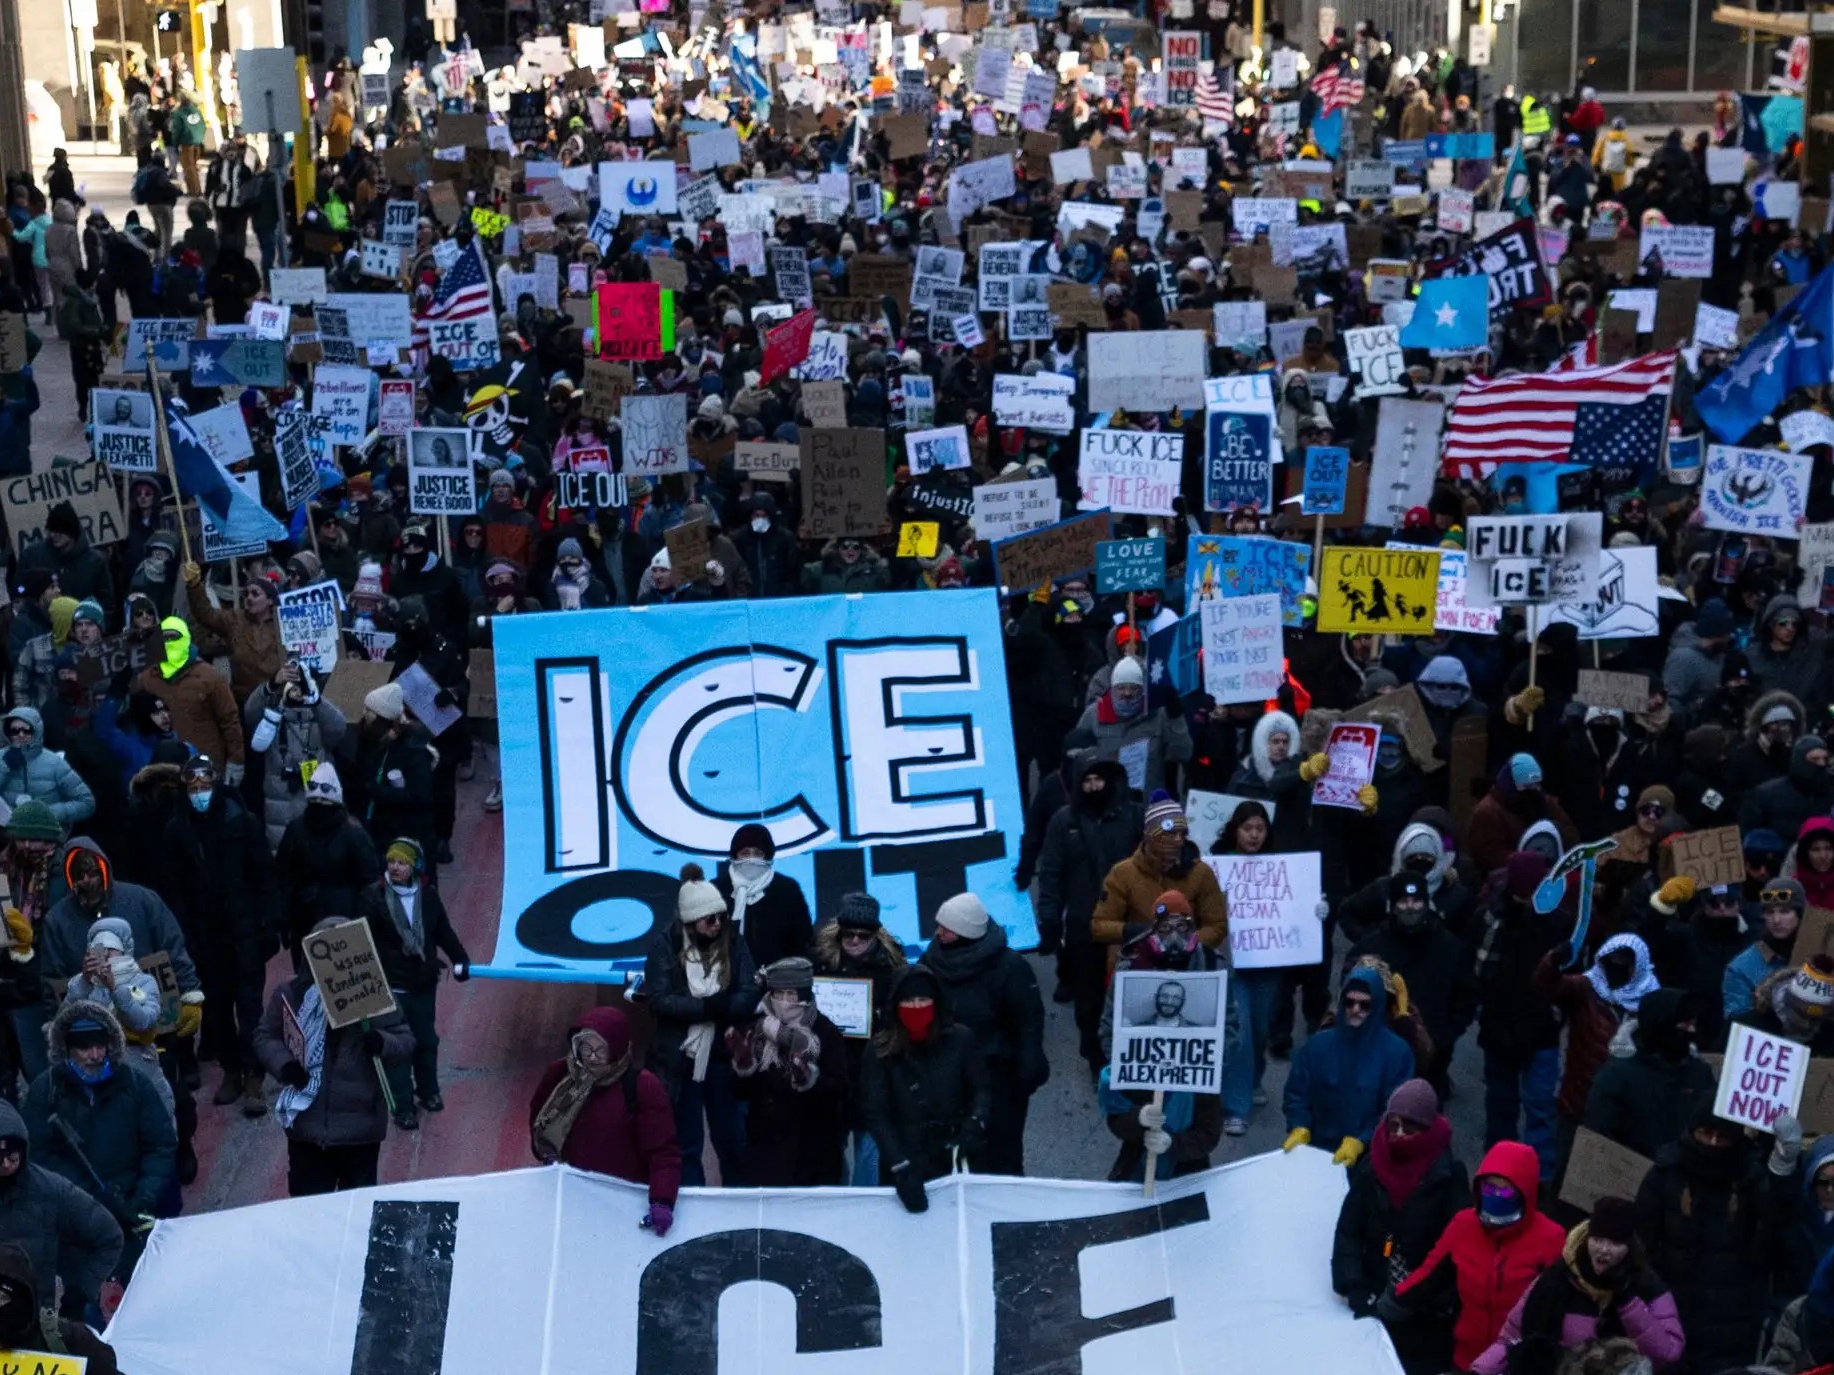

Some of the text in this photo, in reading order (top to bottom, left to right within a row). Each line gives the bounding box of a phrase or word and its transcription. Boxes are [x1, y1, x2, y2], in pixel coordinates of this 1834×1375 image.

[387, 205, 416, 226] STOP
[434, 325, 478, 344] ICE
[1349, 332, 1398, 353] FUCK
[477, 342, 499, 358] OF
[1353, 350, 1401, 388] ICE
[98, 433, 152, 455] JUSTICE
[1085, 432, 1185, 462] FUCK ICE
[1225, 434, 1252, 460] BE
[630, 448, 679, 469] WINS
[1315, 455, 1341, 470] ICE
[1708, 457, 1729, 476] BE
[1212, 460, 1269, 482] BETTER
[1310, 470, 1344, 483] OUT
[7, 461, 113, 506] CHINGA
[414, 476, 469, 495] JUSTICE
[557, 472, 590, 509] ICE
[1107, 477, 1135, 508] THE
[414, 496, 472, 511] RENEE GOOD
[1755, 514, 1782, 530] ICE
[1106, 542, 1155, 559] LOVE
[1475, 524, 1565, 557] FUCK
[1247, 543, 1297, 568] ICE
[1339, 552, 1429, 579] CAUTION
[1116, 567, 1148, 578] FEAR
[1209, 606, 1227, 625] IF
[534, 637, 986, 873] ICE
[1677, 831, 1738, 860] ICE
[1228, 861, 1288, 884] MIGRA
[309, 938, 349, 962] Quo
[332, 980, 386, 1013] Donald?
[1119, 1036, 1216, 1066] JUSTICE
[1744, 1034, 1794, 1073] ICE
[1117, 1065, 1215, 1088] ALEX PRETTI
[1741, 1068, 1787, 1096] OUT
